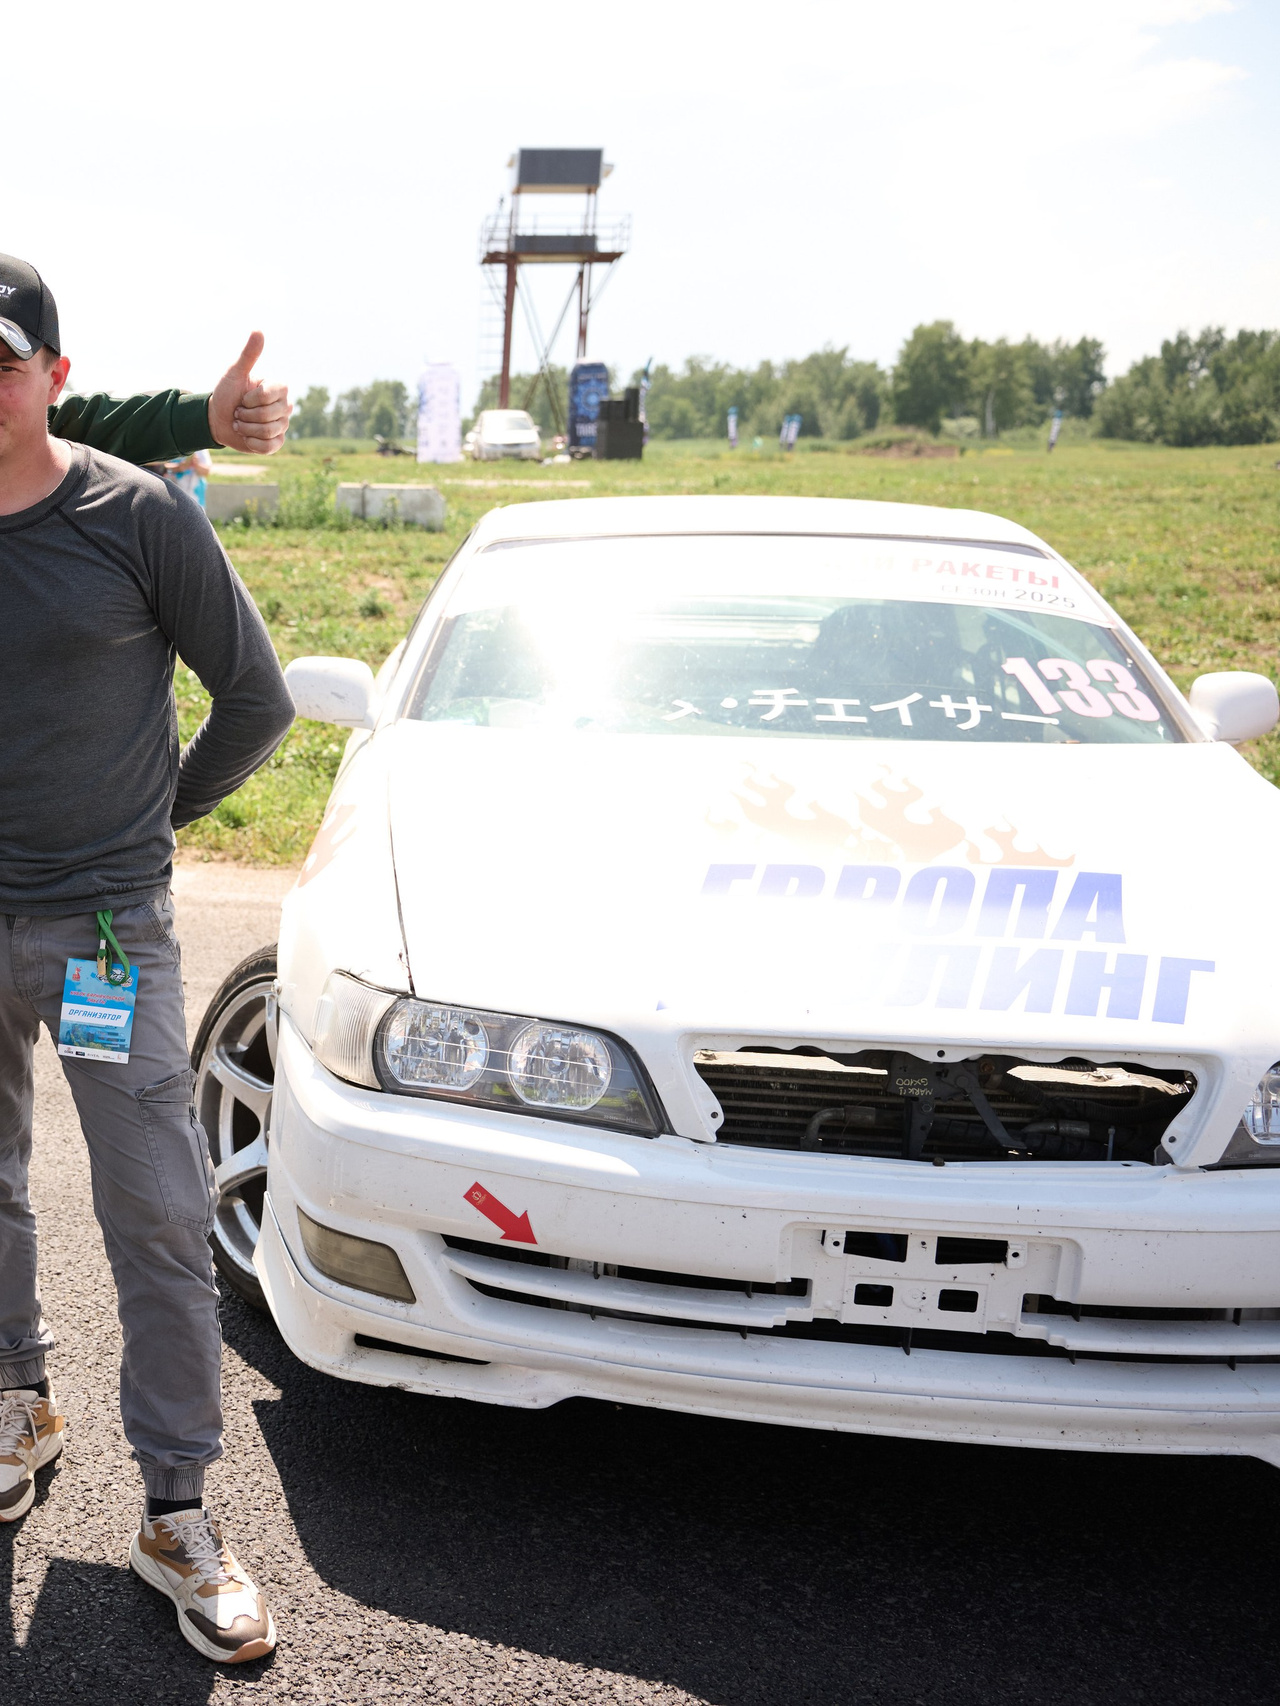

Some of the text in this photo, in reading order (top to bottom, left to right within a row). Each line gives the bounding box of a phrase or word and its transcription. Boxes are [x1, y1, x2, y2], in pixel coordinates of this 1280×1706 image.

[911, 559, 1059, 589] РАКЕТЫ
[1013, 588, 1077, 610] 2025
[1000, 656, 1160, 722] 133
[68, 1009, 121, 1020] ОРГАНИЗАТОР
[896, 1078, 928, 1086] GX100
